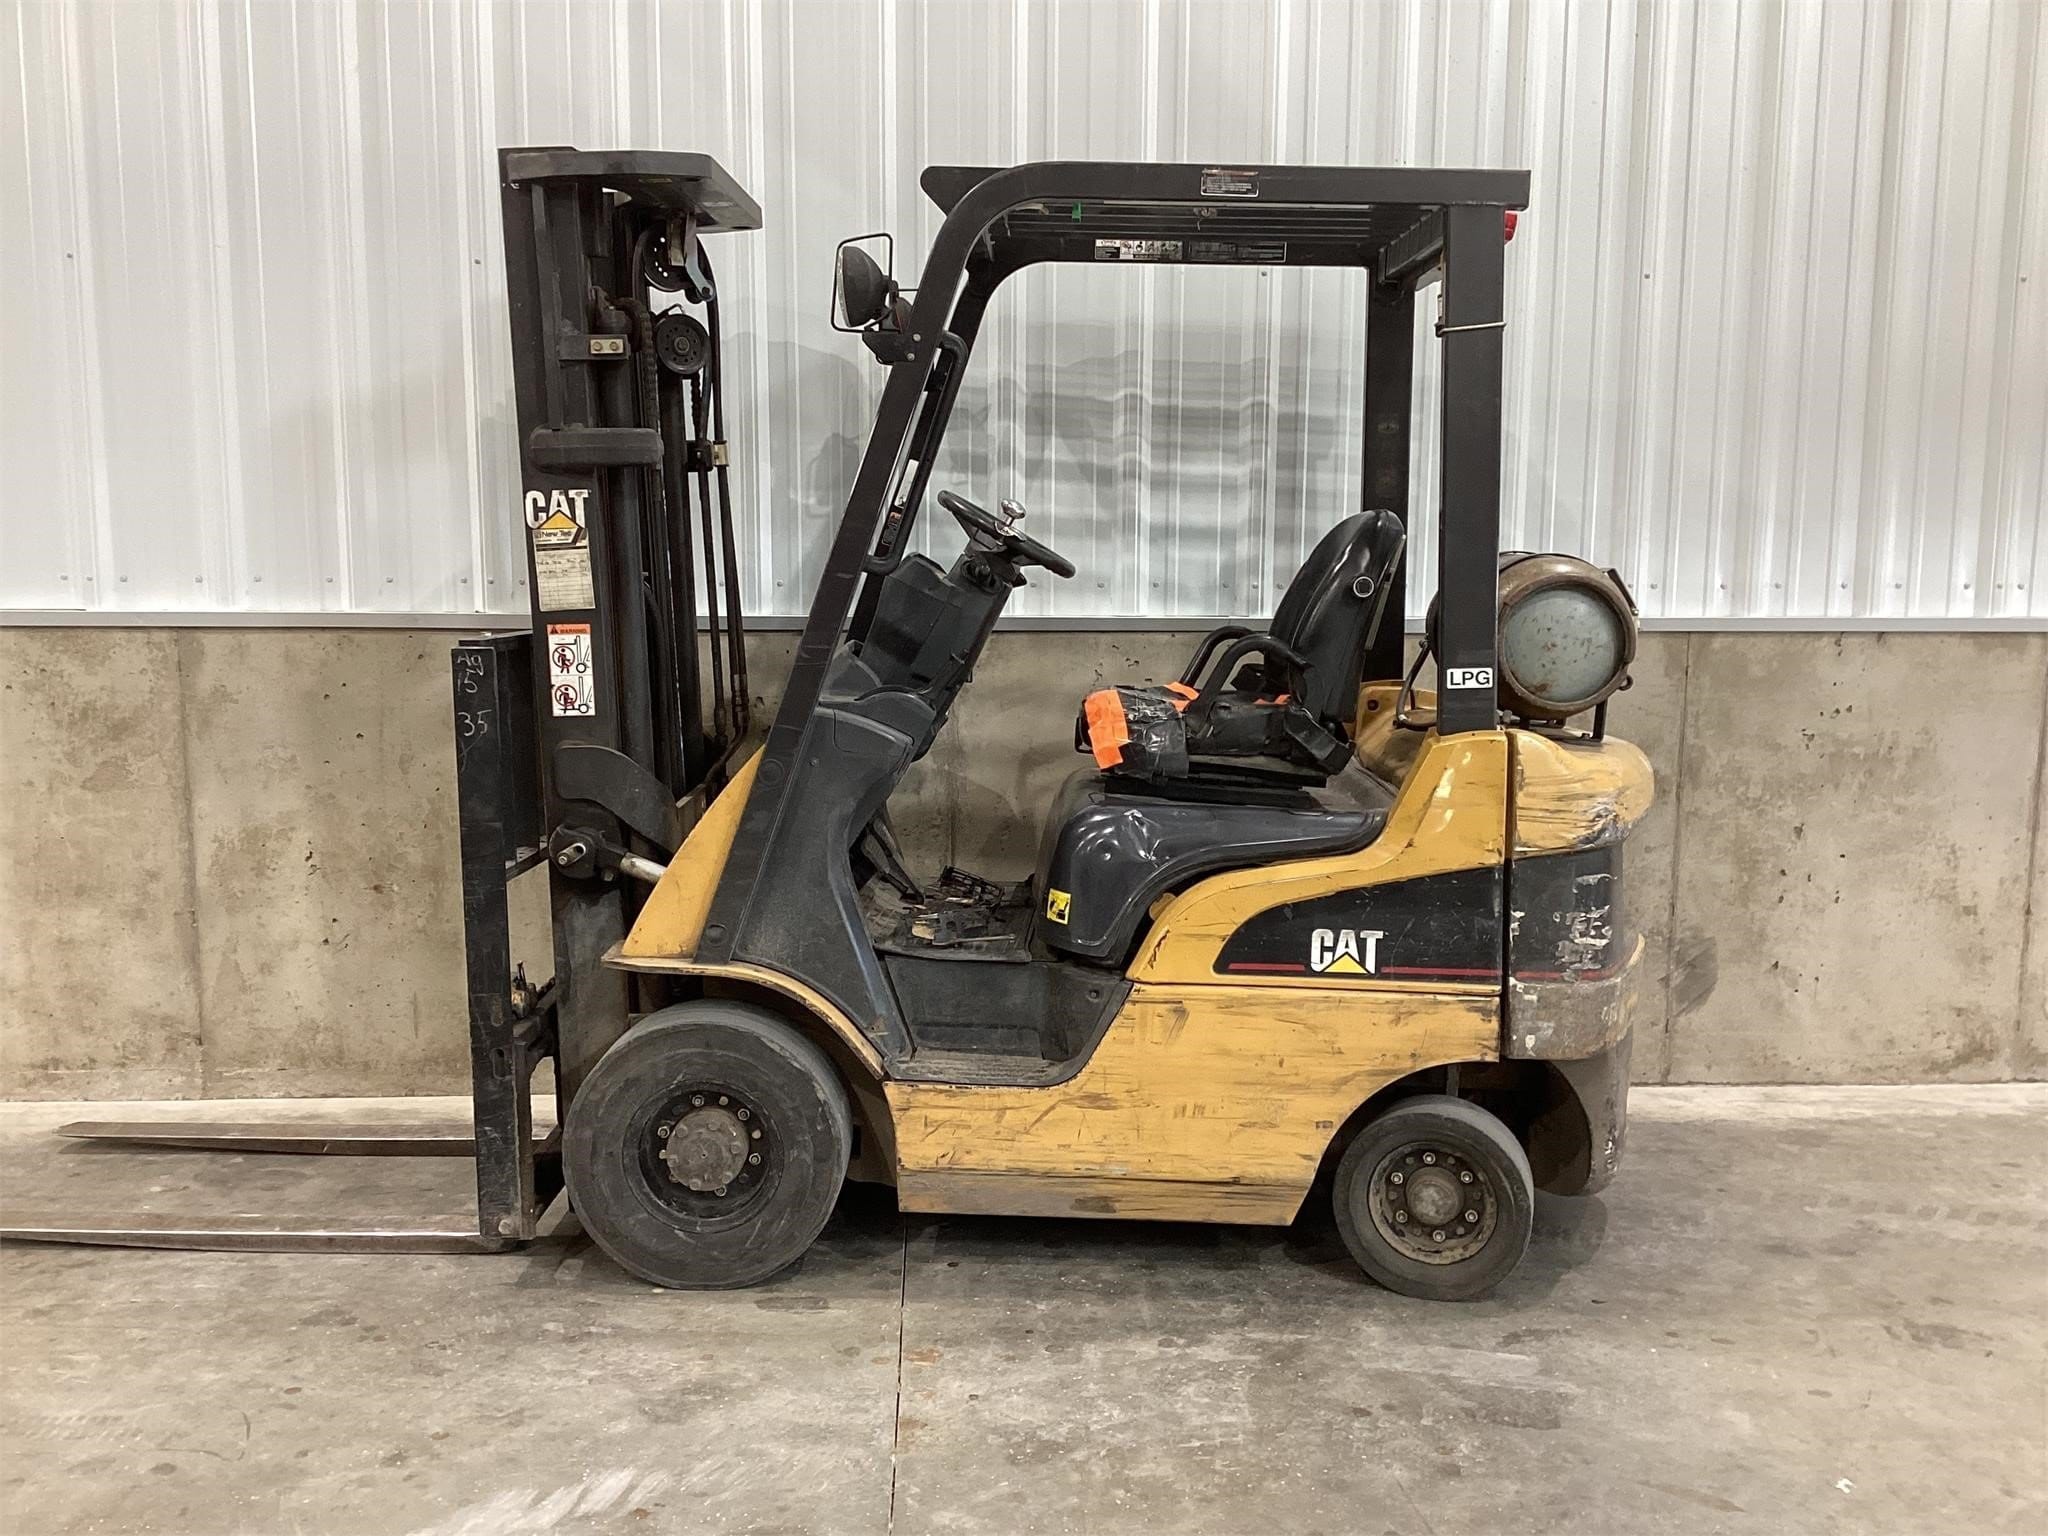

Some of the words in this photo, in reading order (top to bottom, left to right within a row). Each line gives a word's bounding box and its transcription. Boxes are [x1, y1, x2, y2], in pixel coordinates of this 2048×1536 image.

[525, 489, 589, 529] CAT
[1450, 670, 1490, 686] LPG
[457, 708, 493, 737] 35
[1310, 928, 1385, 974] CAT
